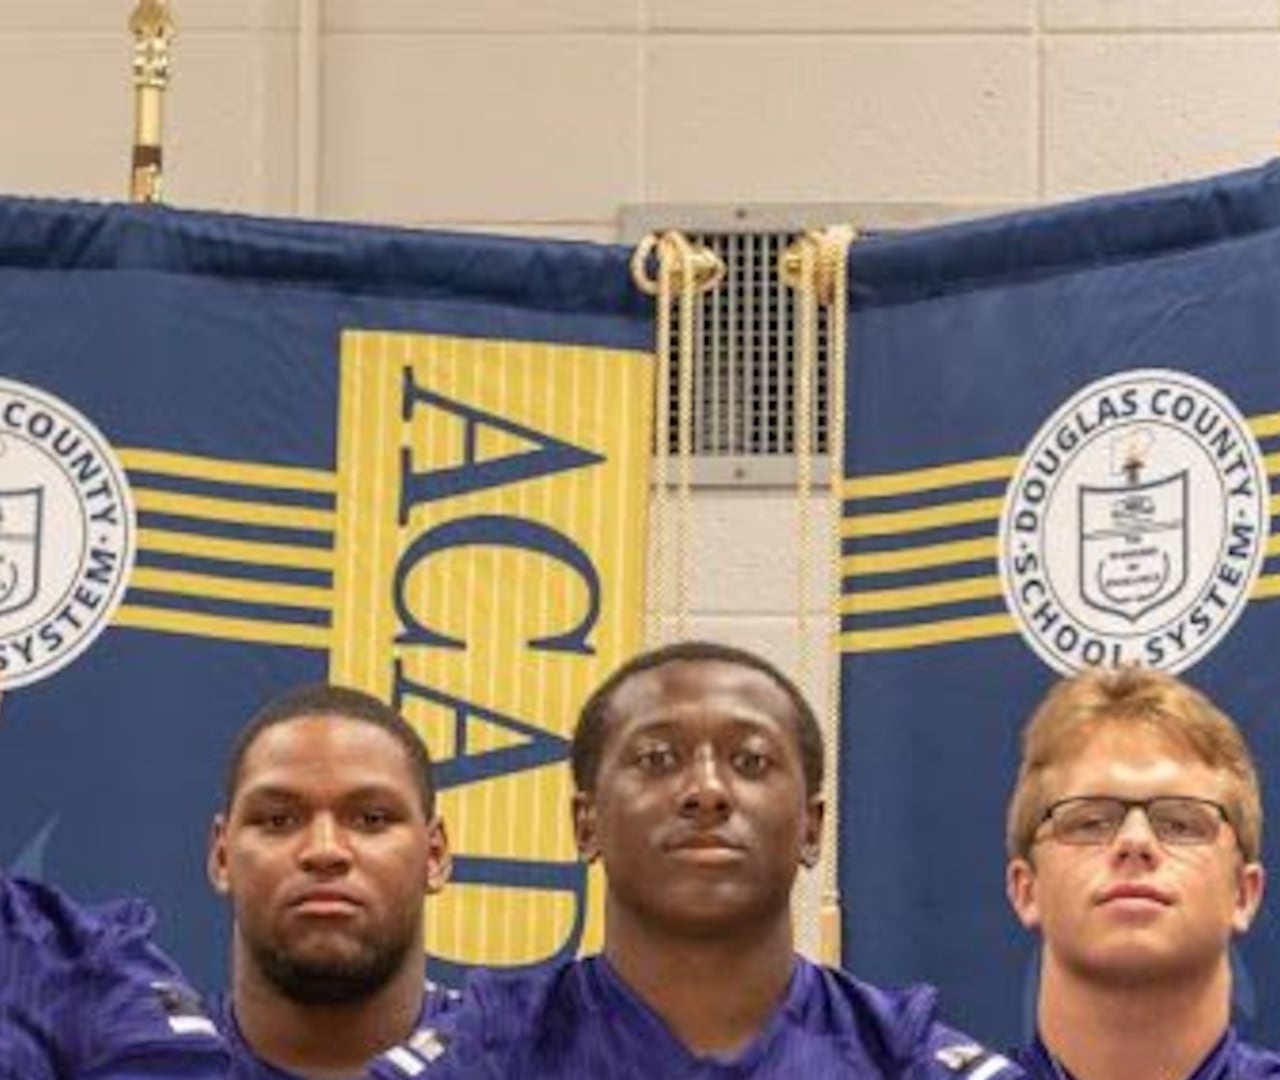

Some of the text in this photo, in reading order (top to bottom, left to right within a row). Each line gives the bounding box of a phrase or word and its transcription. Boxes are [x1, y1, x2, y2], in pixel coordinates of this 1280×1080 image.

[2, 402, 118, 527] COUNTY
[1014, 388, 1254, 533] DOUGLAS COUNTY
[1145, 525, 1254, 665] SYSTEM
